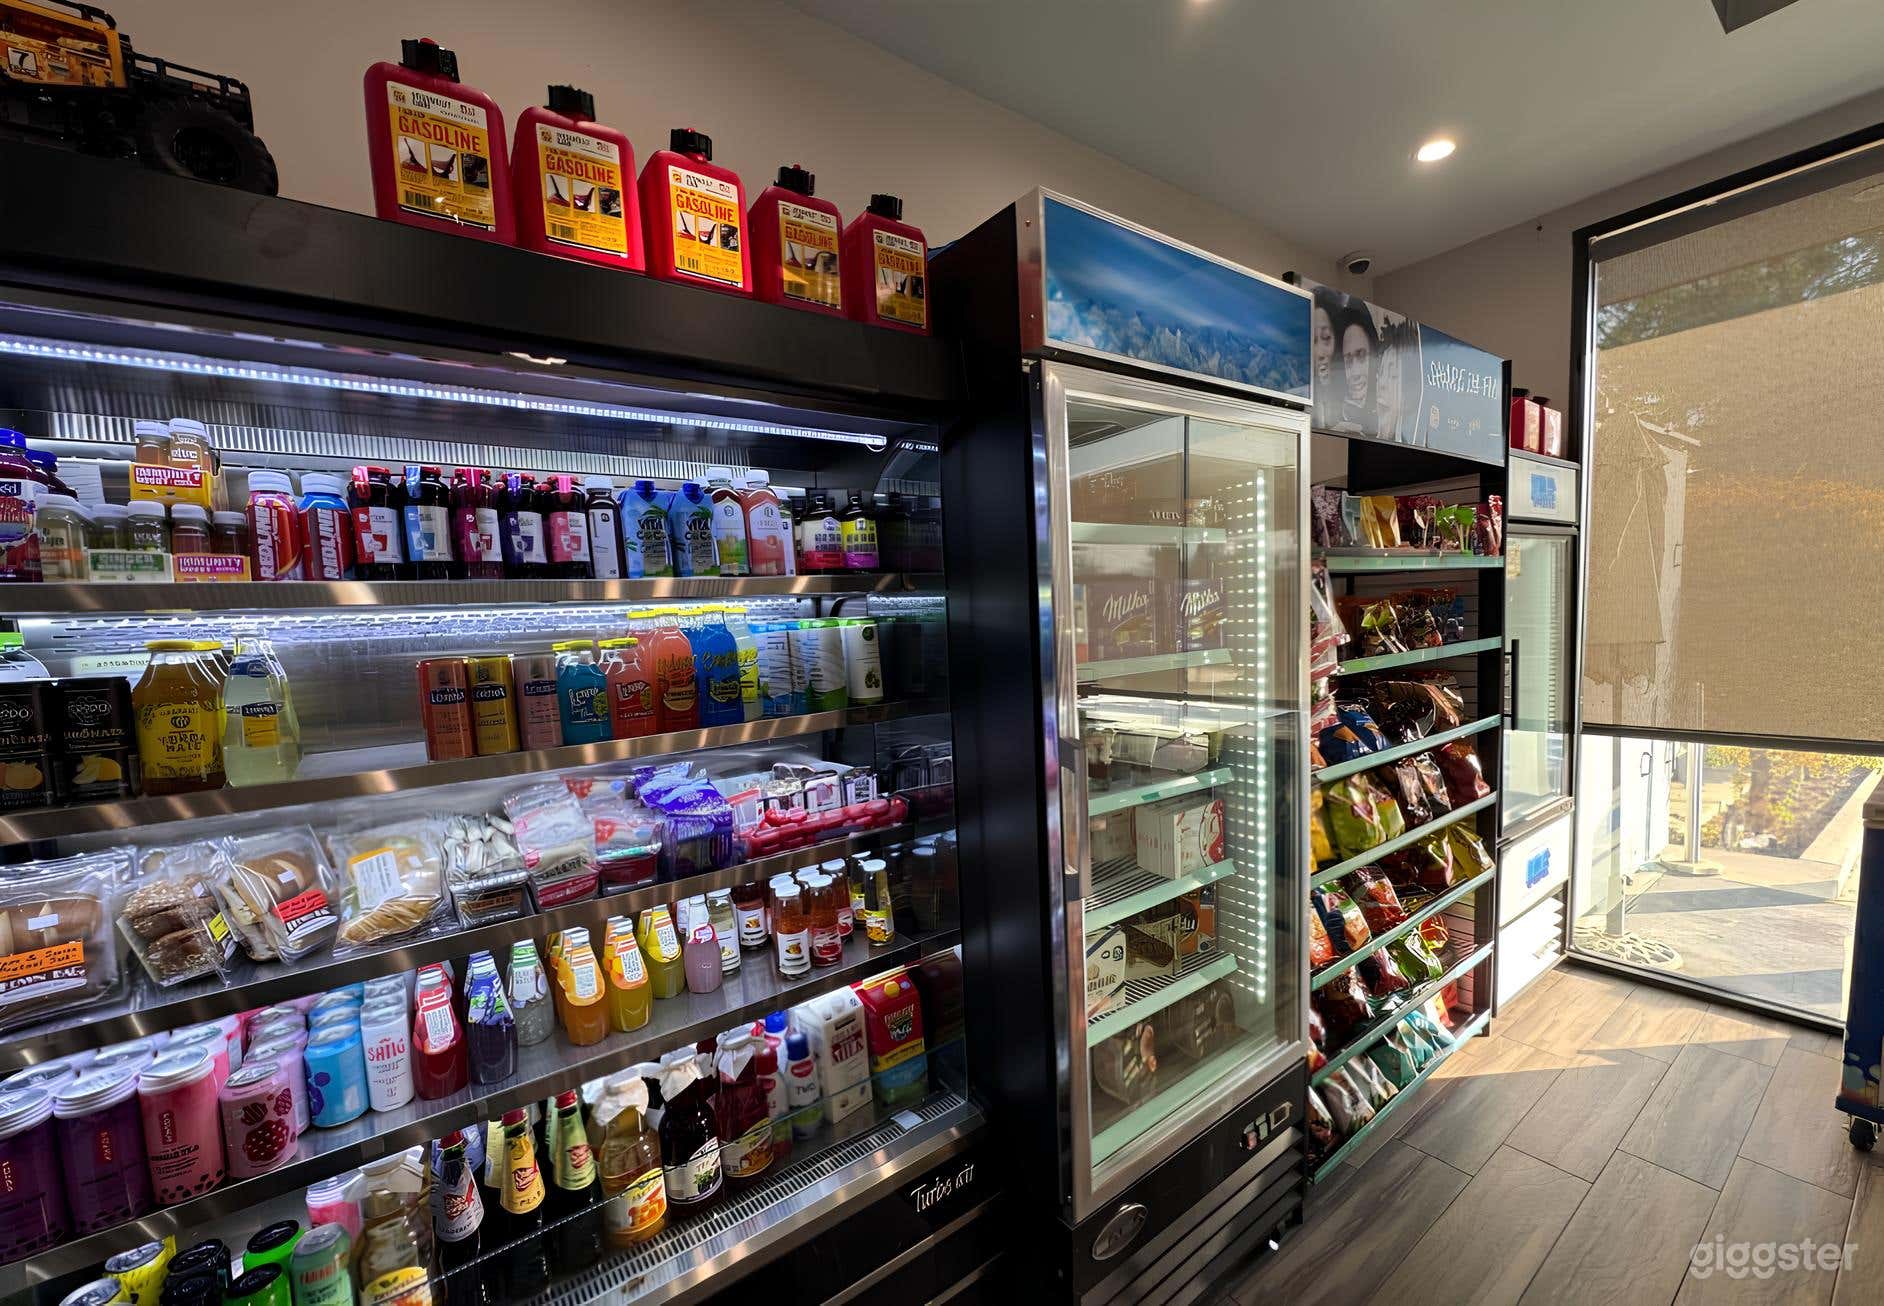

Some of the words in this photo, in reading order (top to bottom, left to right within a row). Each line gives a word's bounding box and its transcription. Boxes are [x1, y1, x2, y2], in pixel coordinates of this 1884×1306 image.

[398, 115, 481, 152] GASOLINE
[545, 153, 615, 188] GASOLINE
[676, 193, 735, 223] GASOLINE
